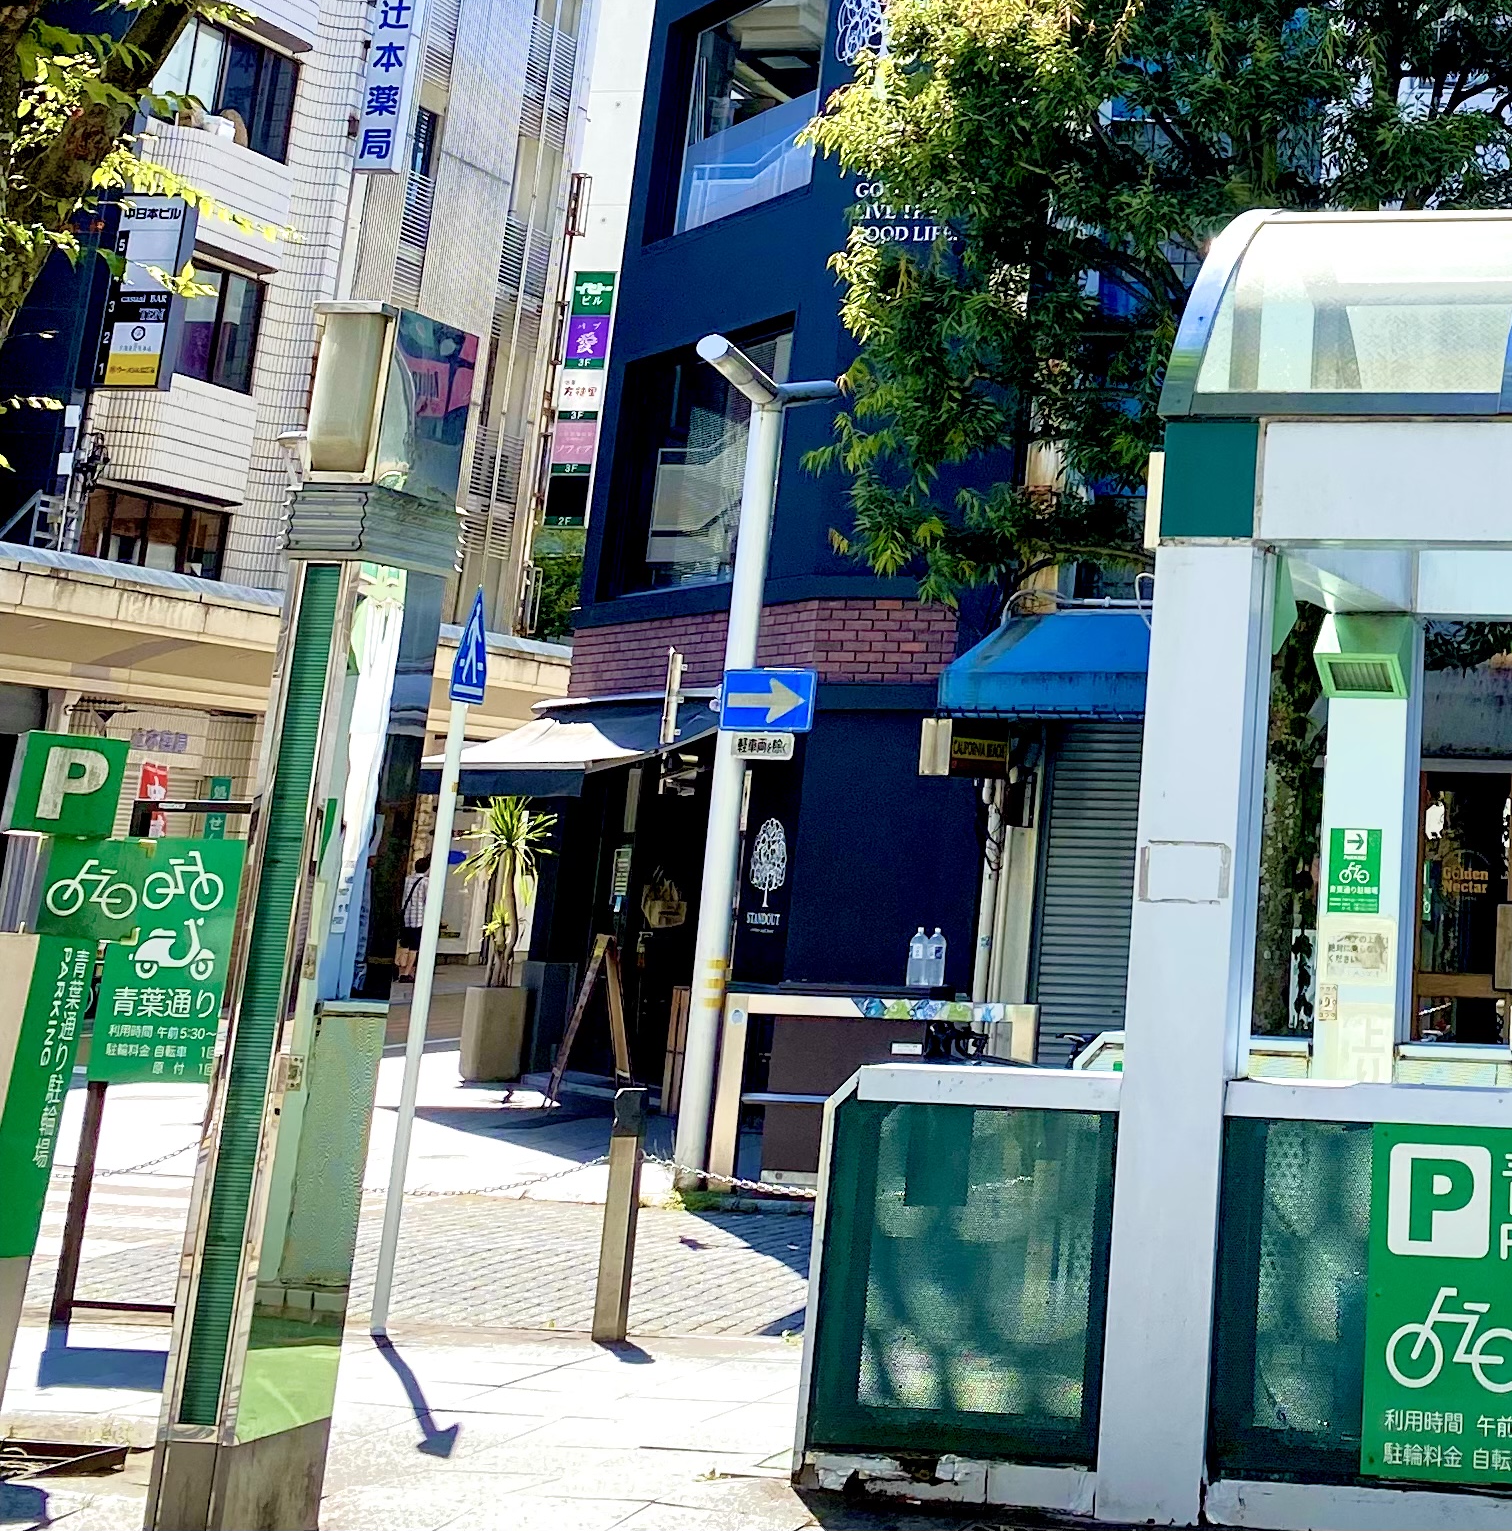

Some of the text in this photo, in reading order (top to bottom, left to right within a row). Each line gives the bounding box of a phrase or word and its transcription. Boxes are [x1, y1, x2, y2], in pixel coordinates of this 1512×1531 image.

[124, 207, 182, 220] 中日本ビル
[118, 239, 126, 252] 5
[108, 300, 116, 313] 3
[139, 307, 166, 321] TEN
[103, 332, 111, 344] 2
[570, 411, 585, 420] 3F
[36, 746, 110, 820] P
[1442, 866, 1489, 881] Golden
[1442, 879, 1488, 894] Nectar
[40, 946, 74, 1068] PARKING
[33, 948, 91, 1168] 青葉通り駐輪場
[154, 1044, 188, 1059] 自転車
[1408, 1157, 1475, 1242] P
[1383, 1408, 1464, 1435] 利用時間
[1382, 1441, 1463, 1468] 駐輪料金
